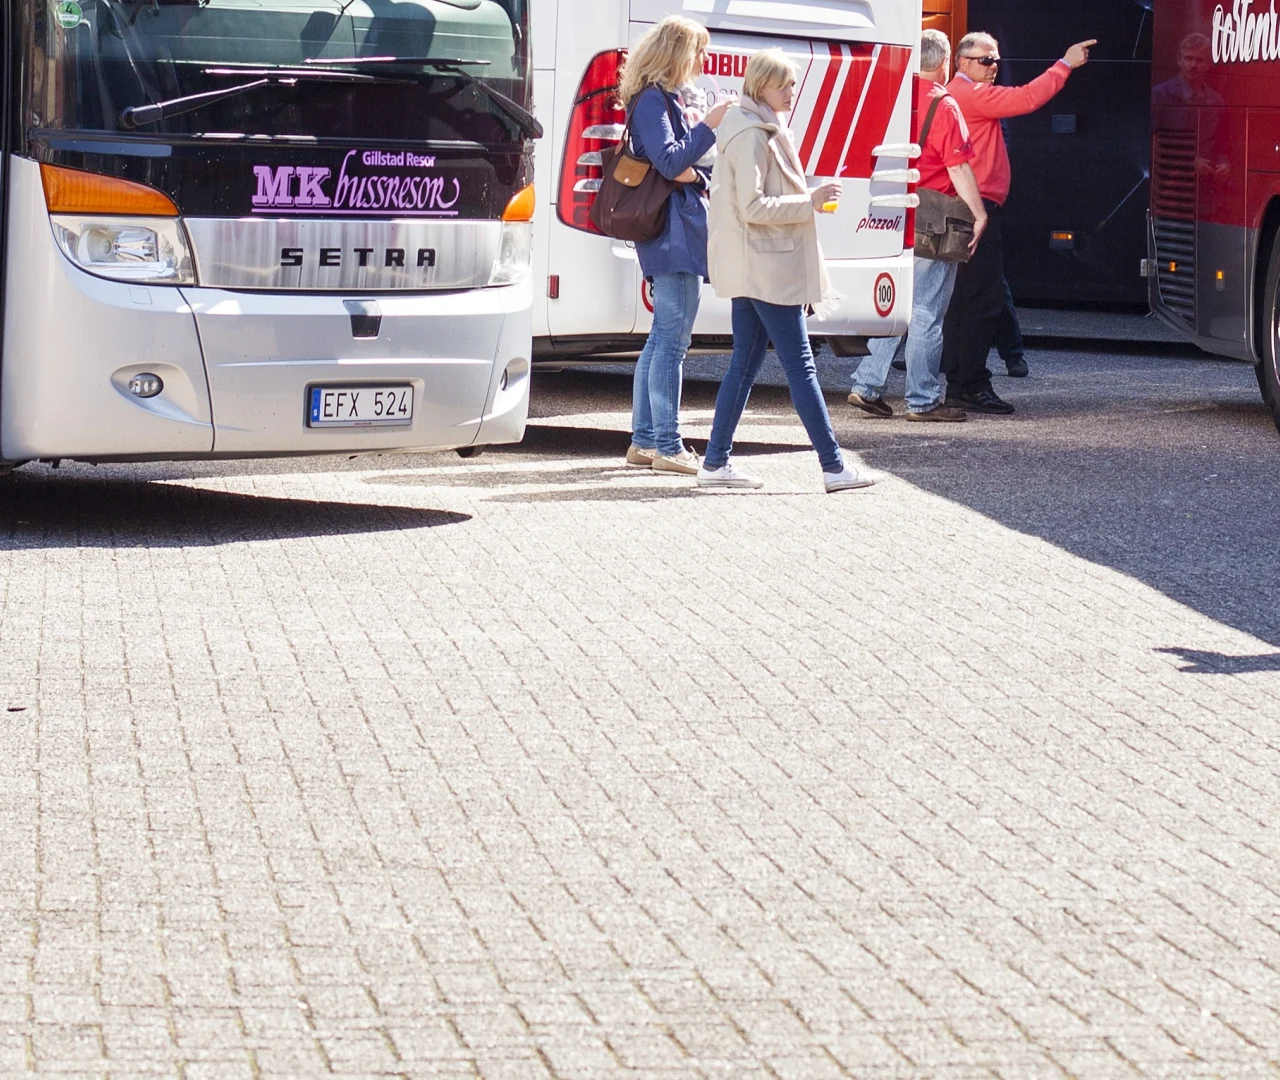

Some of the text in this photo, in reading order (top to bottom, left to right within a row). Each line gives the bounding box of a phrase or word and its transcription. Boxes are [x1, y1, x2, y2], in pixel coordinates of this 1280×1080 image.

[362, 151, 436, 168] Gillstad Resor
[251, 166, 332, 208] MK
[855, 213, 903, 234] piazzoli
[280, 247, 436, 267] SETRA
[878, 284, 892, 303] 100
[312, 409, 318, 417] S
[323, 391, 408, 418] EFX 524
